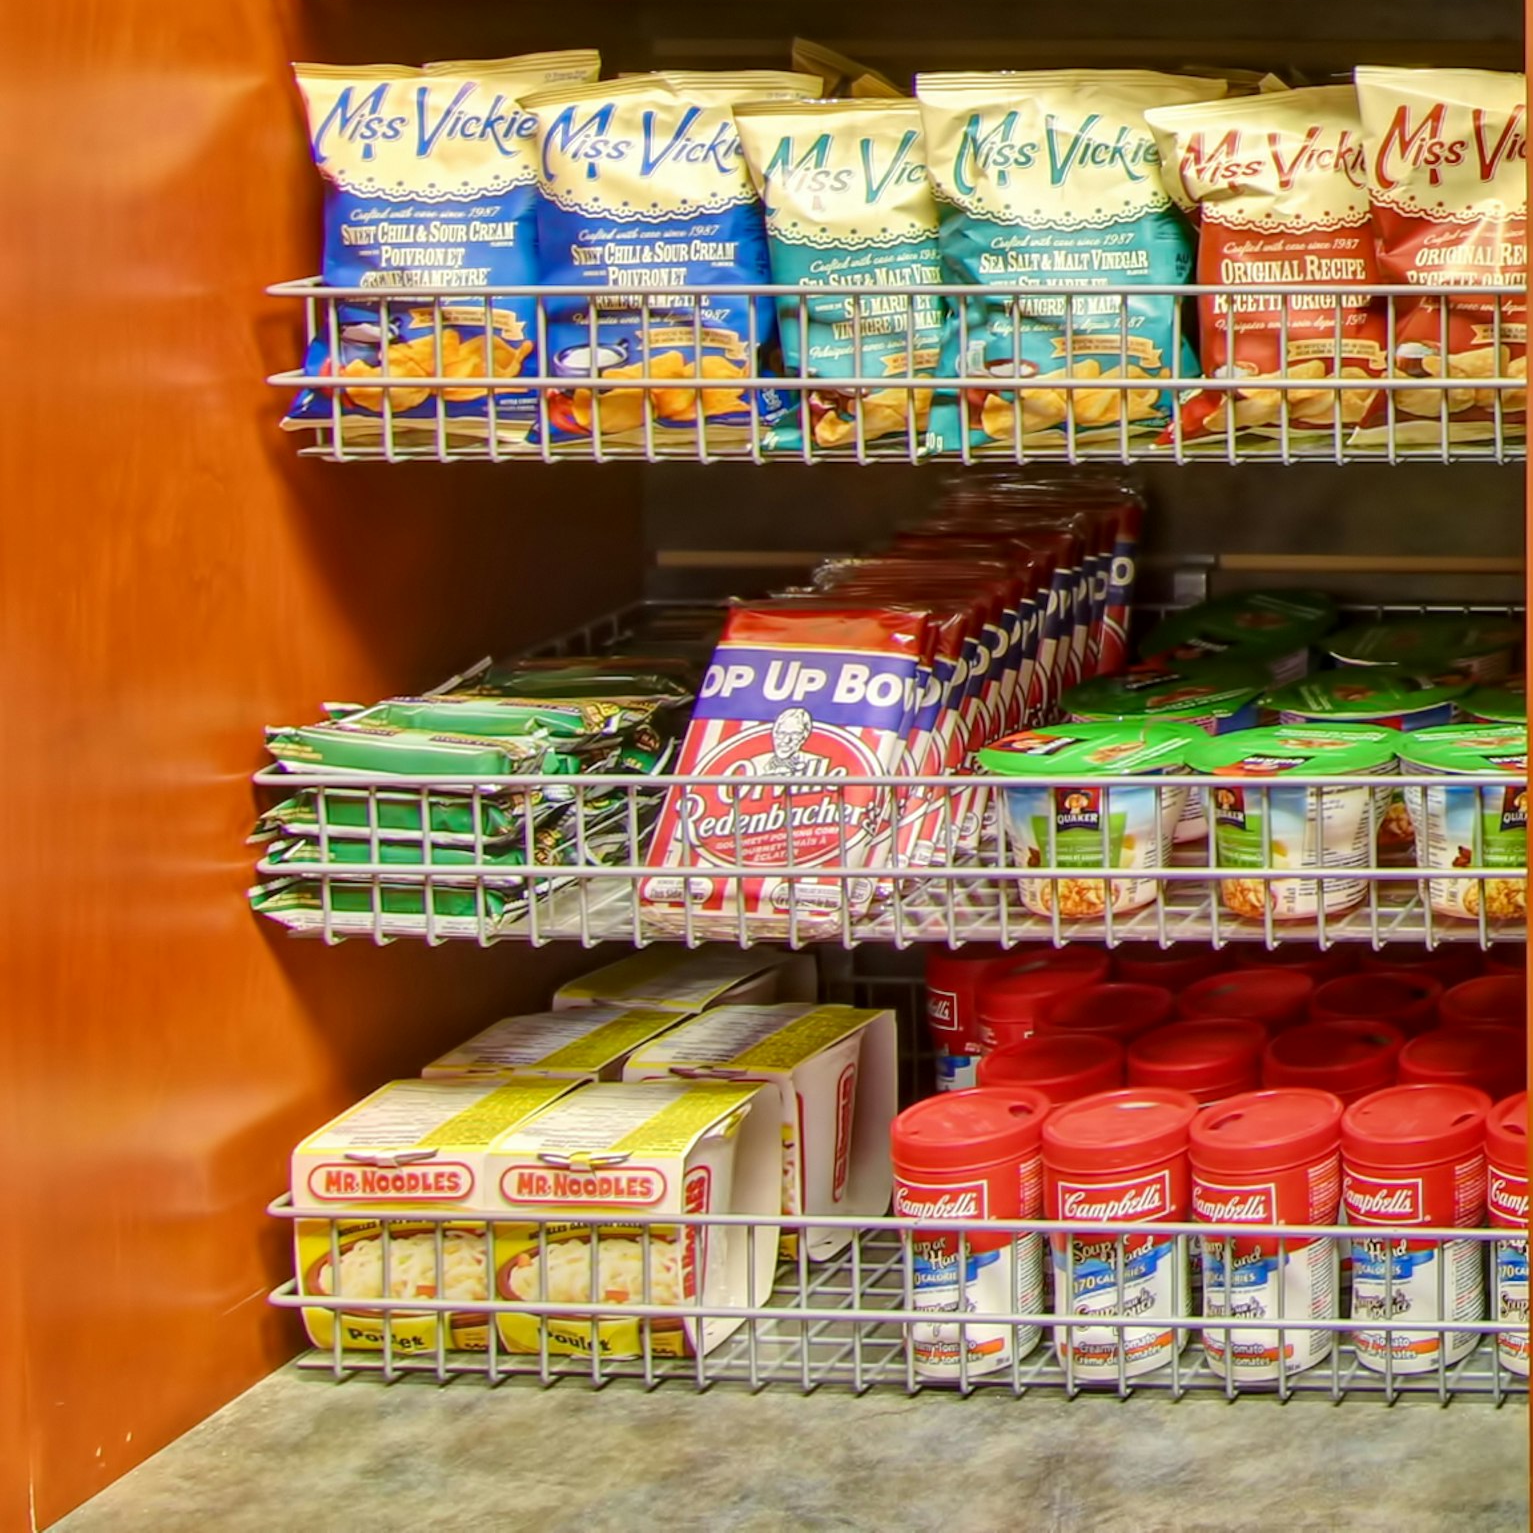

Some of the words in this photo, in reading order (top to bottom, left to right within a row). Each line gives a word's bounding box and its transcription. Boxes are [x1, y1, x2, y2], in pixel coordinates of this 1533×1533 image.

[314, 82, 410, 163] Miss
[543, 103, 639, 184] Miss
[955, 111, 1037, 197] Miss
[1380, 103, 1469, 192] Miss
[764, 133, 854, 218] Miss
[1180, 128, 1263, 204] Miss
[467, 205, 502, 219] 1987
[341, 223, 376, 245] SWEET
[378, 222, 415, 243] CHILI
[429, 221, 467, 243] SOUR
[470, 220, 516, 242] CREAM
[1102, 232, 1135, 246] 1987
[1332, 238, 1360, 251] 1987
[381, 247, 445, 267] POIVRON
[447, 248, 465, 268] ET
[571, 244, 602, 265] SWEET
[604, 243, 641, 264] CHILI
[655, 242, 689, 263] SOUR
[691, 240, 736, 262] CREAM
[979, 253, 1005, 275] SEA
[1008, 251, 1040, 273] SALT
[1053, 250, 1089, 270] MALT
[1091, 248, 1149, 269] VINEGAR
[1415, 243, 1497, 267] ORIGINAL
[1220, 259, 1304, 284] ORIGINAL
[1304, 255, 1366, 281] RECIPE
[762, 660, 825, 702] UP
[1056, 812, 1099, 826] QUAKER
[361, 1170, 461, 1195] NOODLES
[553, 1173, 654, 1198] NOODLES
